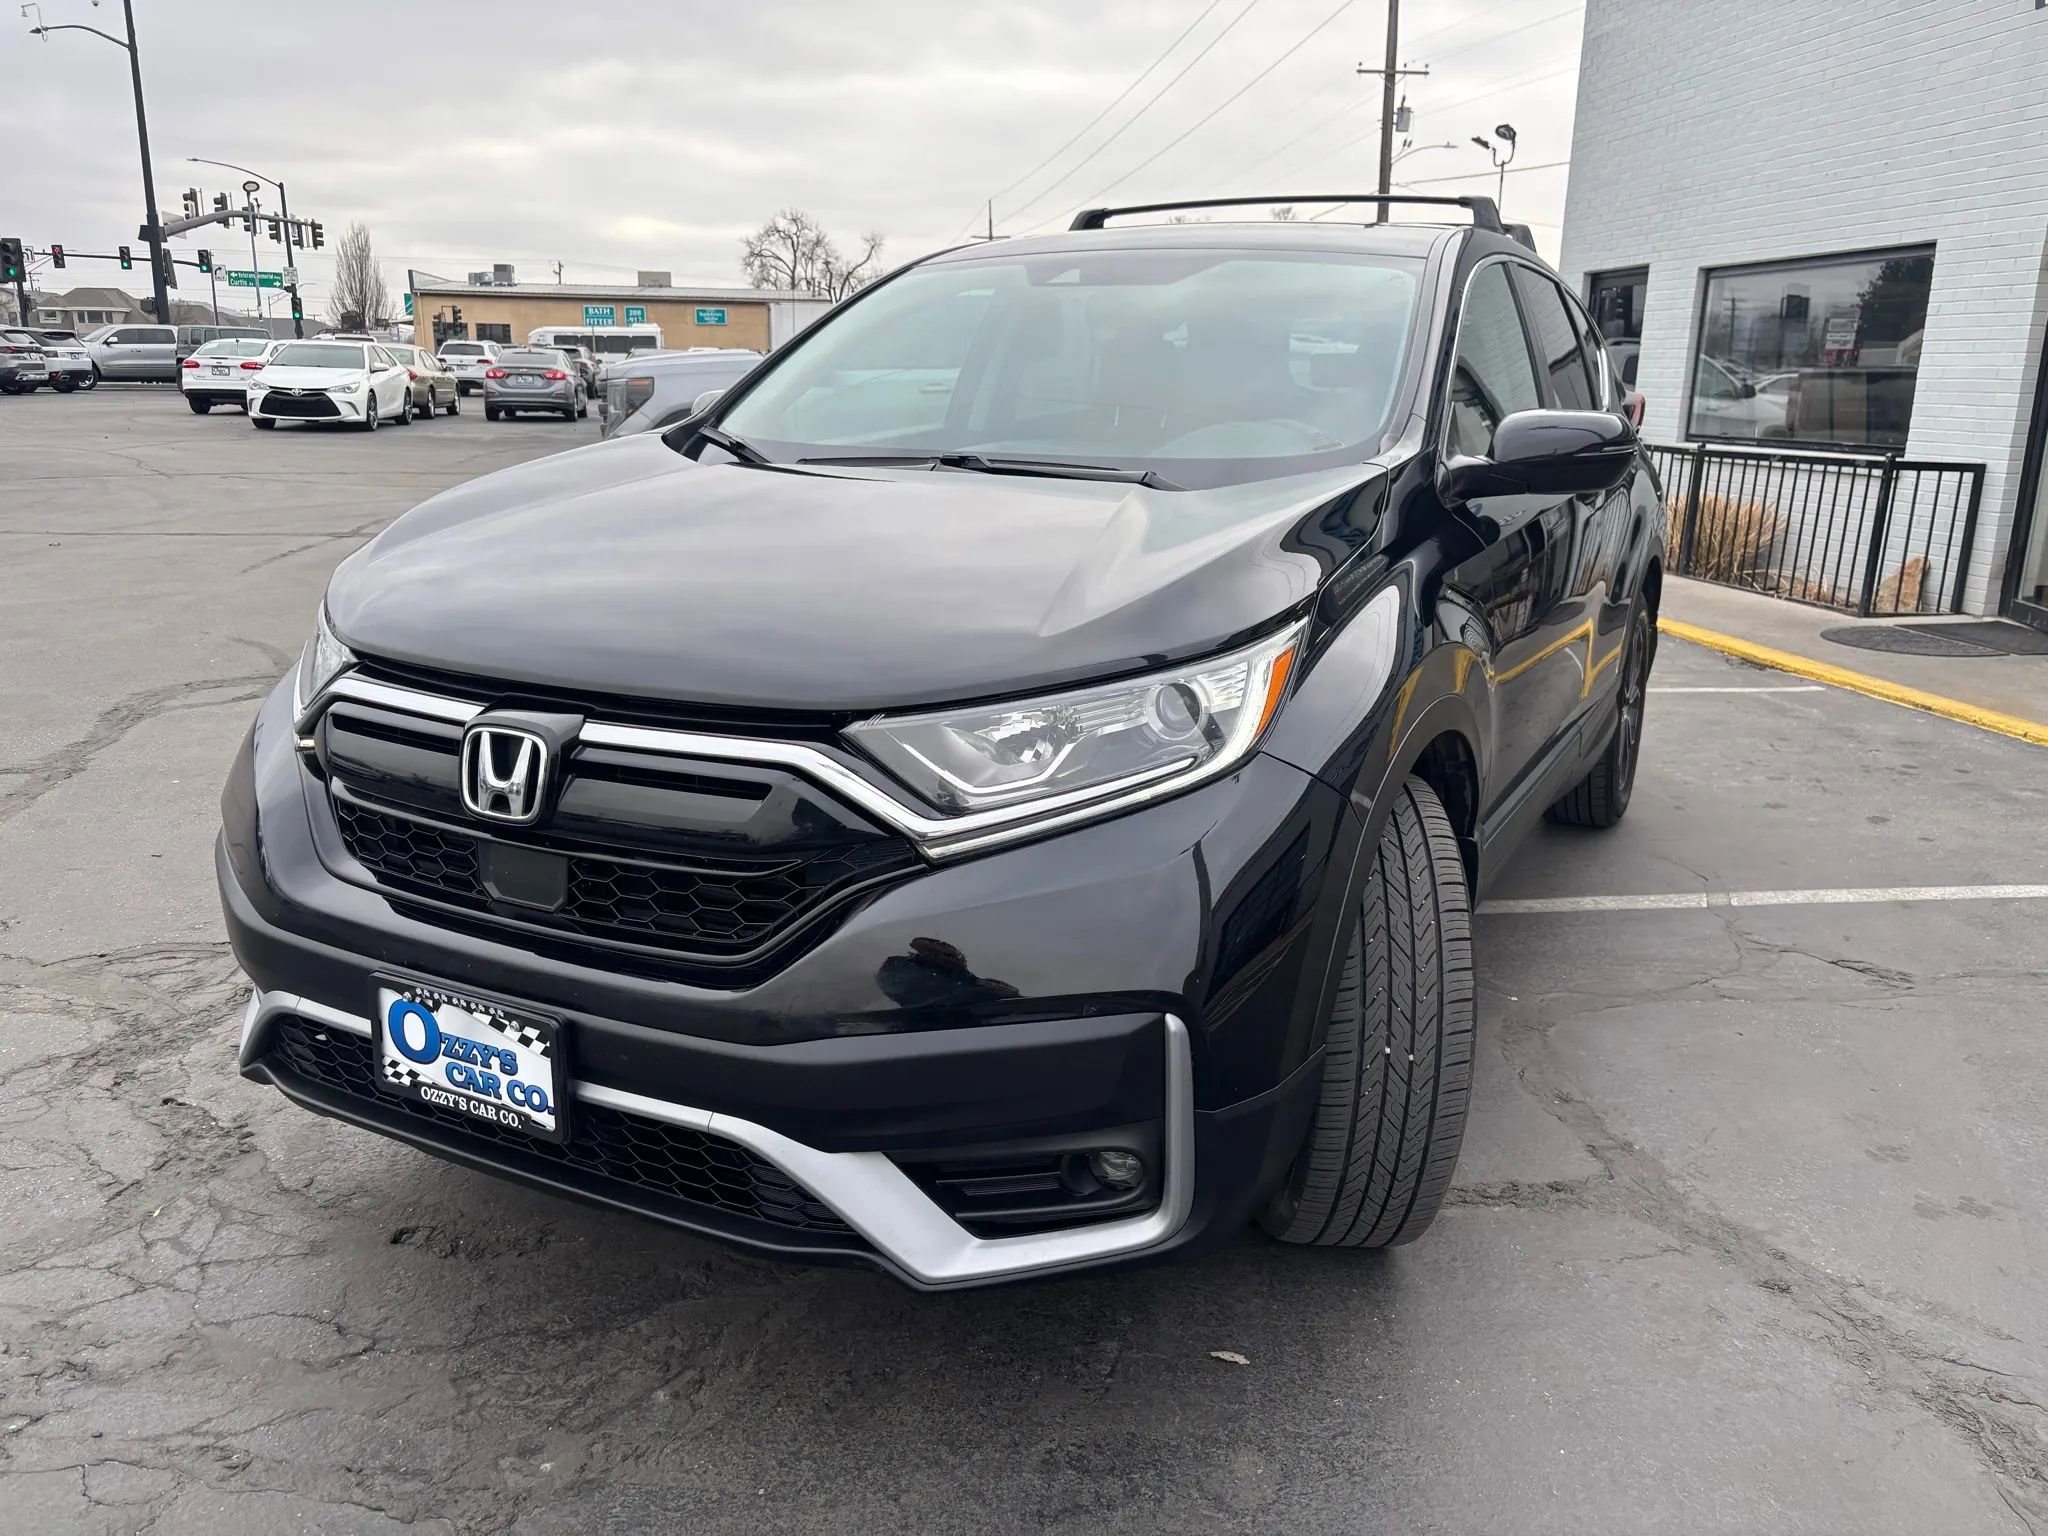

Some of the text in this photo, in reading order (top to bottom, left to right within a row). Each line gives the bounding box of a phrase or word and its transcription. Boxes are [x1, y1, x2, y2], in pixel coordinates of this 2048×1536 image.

[388, 999, 518, 1076] OZZY'S
[420, 1086, 522, 1129] OZZY'S CAR CO.
[445, 1062, 554, 1116] CAR CO.
